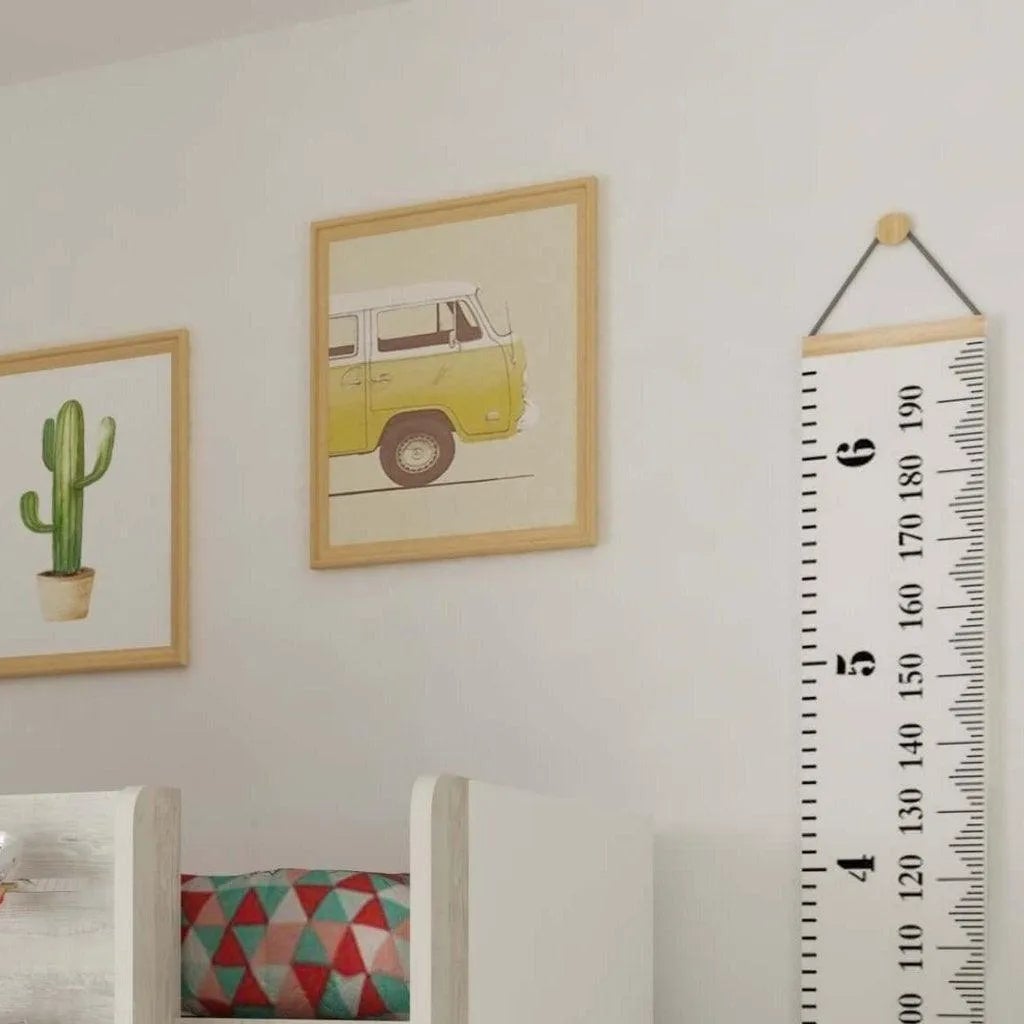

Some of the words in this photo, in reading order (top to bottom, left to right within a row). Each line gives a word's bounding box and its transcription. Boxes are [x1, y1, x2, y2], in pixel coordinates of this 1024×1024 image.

[898, 384, 923, 432] 190
[836, 438, 875, 467] 6
[898, 454, 923, 501] 180
[898, 513, 923, 560] 170
[898, 583, 923, 630] 160
[836, 650, 875, 677] 5
[898, 653, 923, 700] 150
[898, 723, 923, 769] 140
[898, 788, 923, 835] 130
[836, 854, 875, 882] 4
[898, 854, 923, 901] 120
[898, 924, 923, 970] 110
